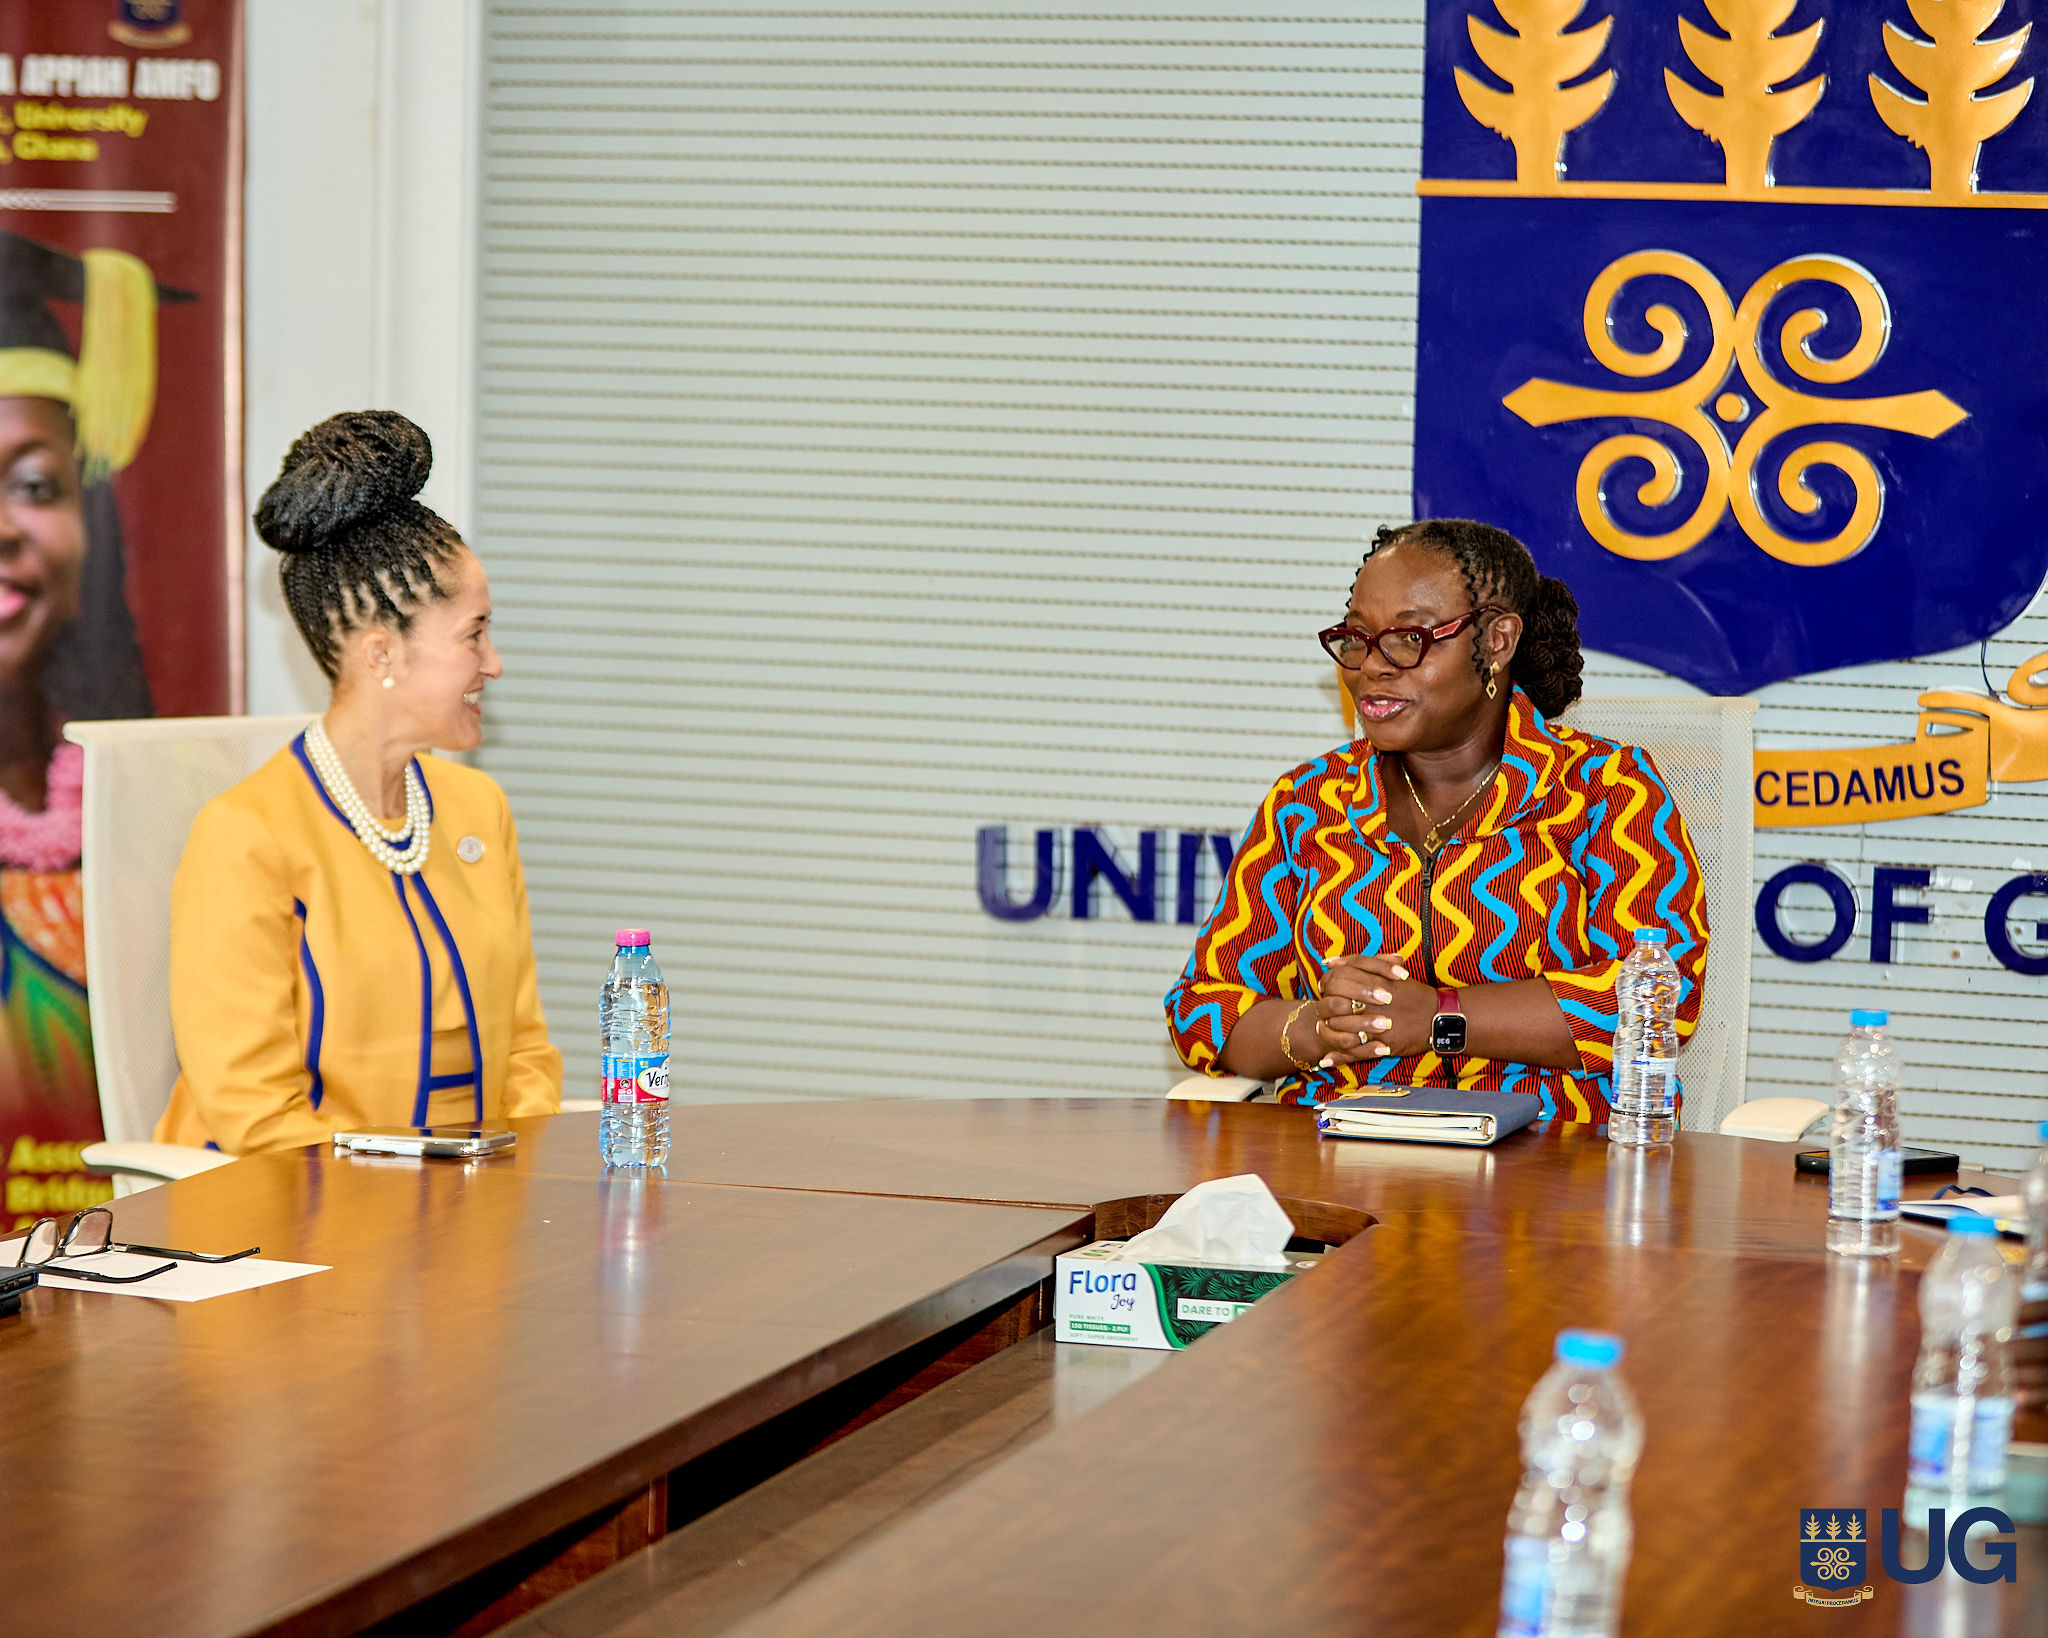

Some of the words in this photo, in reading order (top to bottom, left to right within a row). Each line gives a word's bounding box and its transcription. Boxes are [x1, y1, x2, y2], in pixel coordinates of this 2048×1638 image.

[1754, 759, 1965, 807] CEDAMUS
[1754, 862, 1936, 964] OF
[1069, 1270, 1137, 1294] Flora
[1110, 1294, 1135, 1311] Joy
[1182, 1304, 1212, 1315] DARE
[1215, 1307, 1230, 1316] TO
